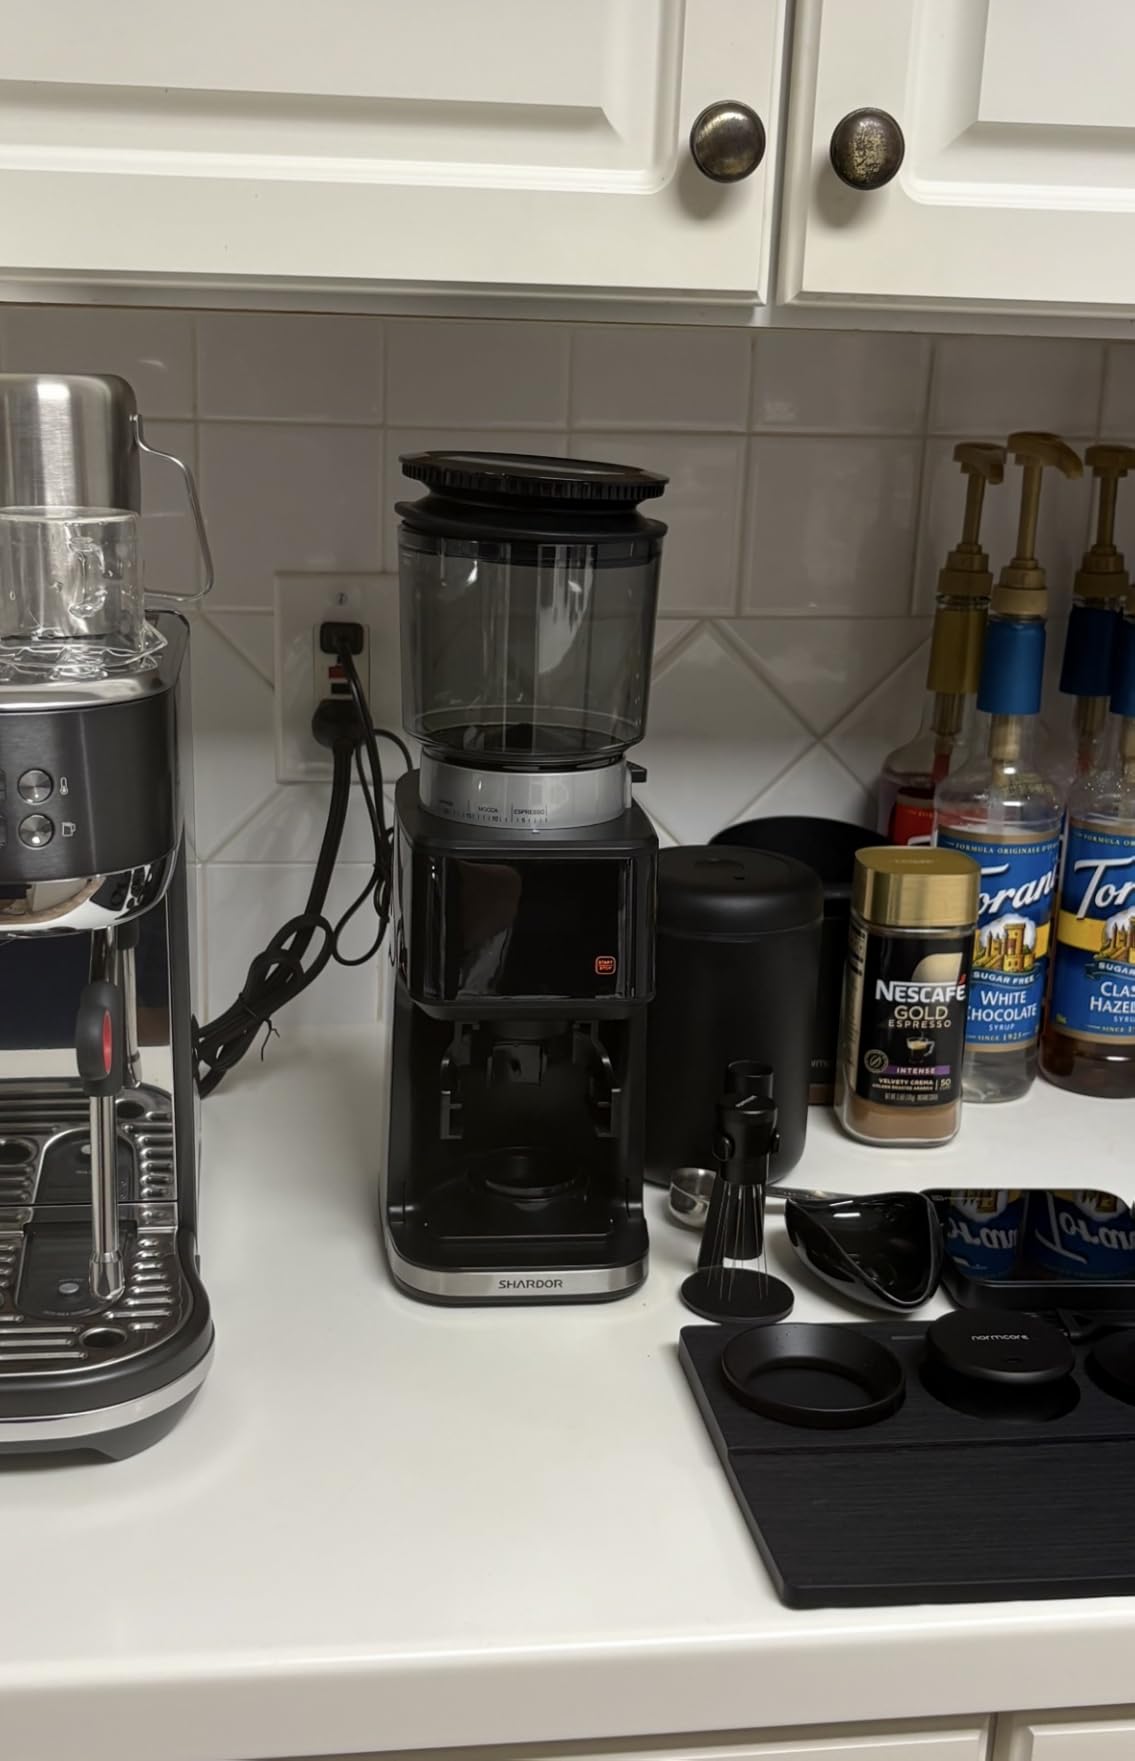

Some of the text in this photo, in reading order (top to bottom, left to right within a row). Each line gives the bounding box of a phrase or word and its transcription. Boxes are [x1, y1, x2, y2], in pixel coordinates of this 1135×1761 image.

[514, 808, 545, 816] ESPRESSO
[956, 842, 994, 854] FORMULA
[973, 971, 1035, 985] SUGAR FREE
[875, 973, 967, 1004] NESCAFÉ
[980, 990, 1028, 1006] WHITE
[894, 1005, 948, 1020] GOLD
[967, 1003, 1038, 1023] HOCOLATE
[888, 1019, 952, 1028] ESPRESSO
[988, 1023, 1016, 1031] SYRUP
[896, 1066, 936, 1075] INTENSE
[498, 1279, 563, 1289] SHARDOR
[971, 1333, 1029, 1341] normcore
